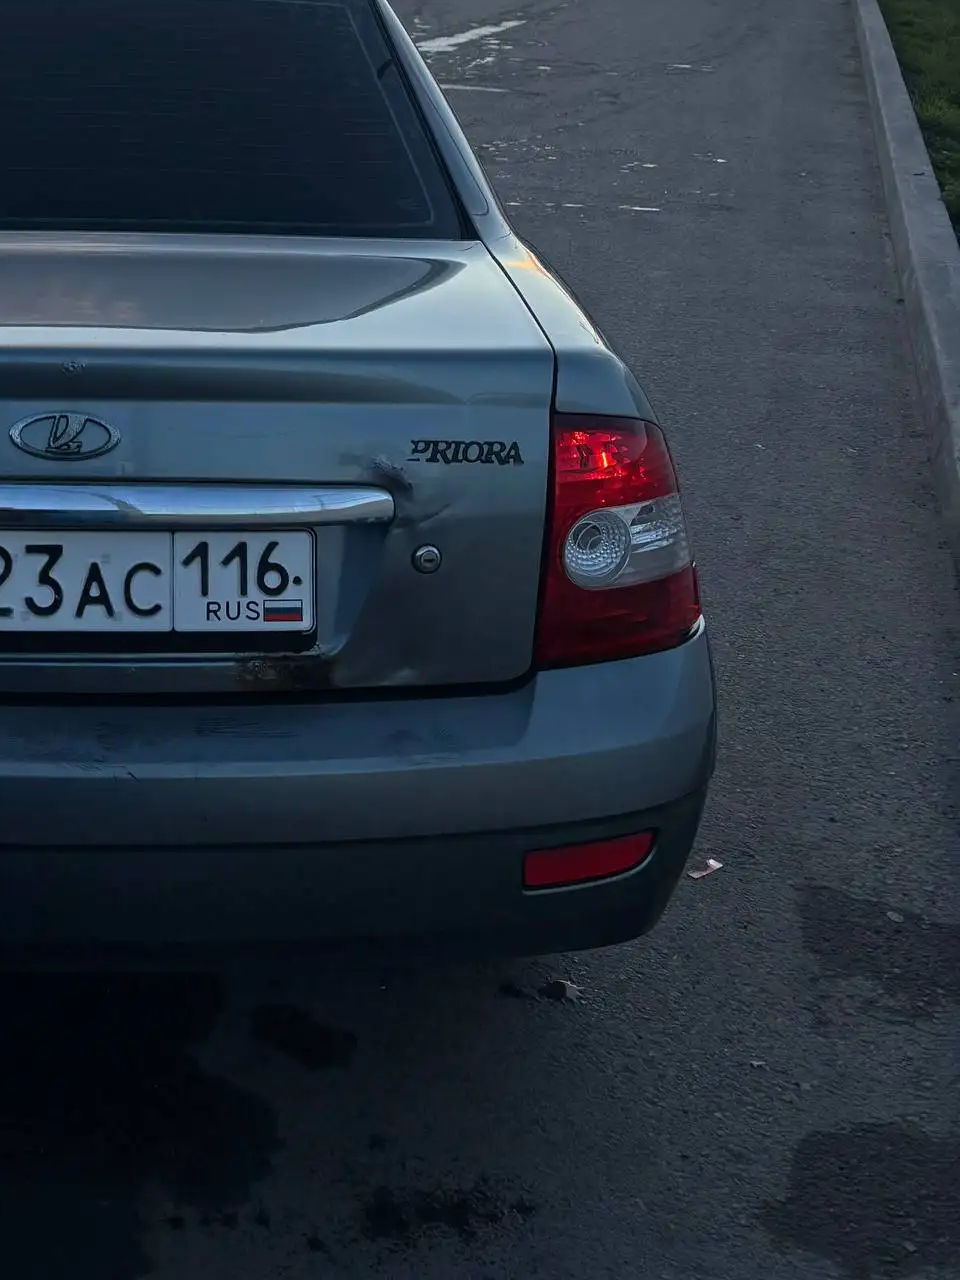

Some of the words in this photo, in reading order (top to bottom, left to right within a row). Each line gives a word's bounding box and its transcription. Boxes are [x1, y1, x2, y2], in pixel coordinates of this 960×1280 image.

[406, 439, 525, 466] PRIORA
[182, 541, 289, 597] 116
[206, 601, 261, 621] RUS
